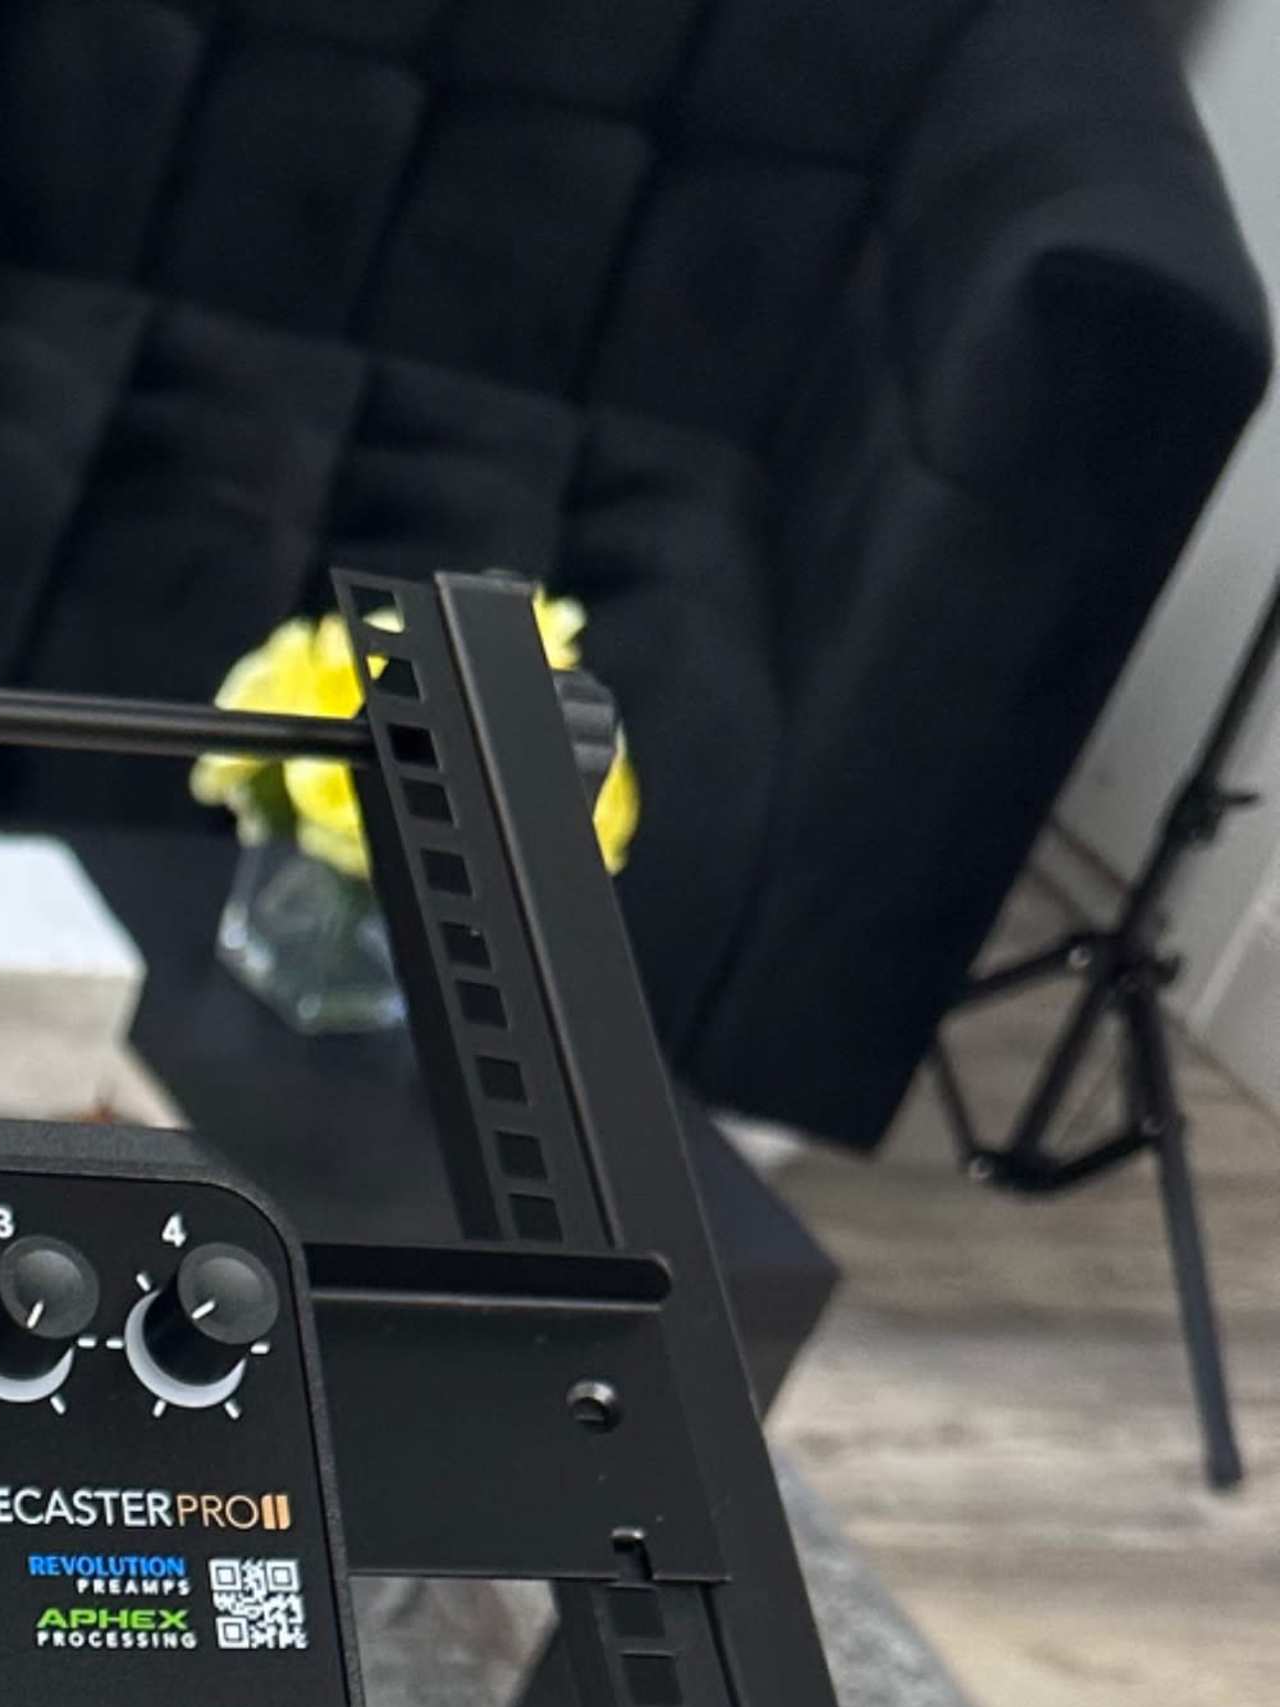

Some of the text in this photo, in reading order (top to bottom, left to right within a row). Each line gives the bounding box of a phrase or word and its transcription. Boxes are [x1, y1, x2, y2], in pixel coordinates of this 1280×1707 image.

[161, 1214, 186, 1247] 4
[28, 1554, 185, 1577] REVOLUTION
[77, 1578, 191, 1596] PREAMPS
[37, 1608, 188, 1630] APHEX
[37, 1631, 197, 1649] PROCESSING
